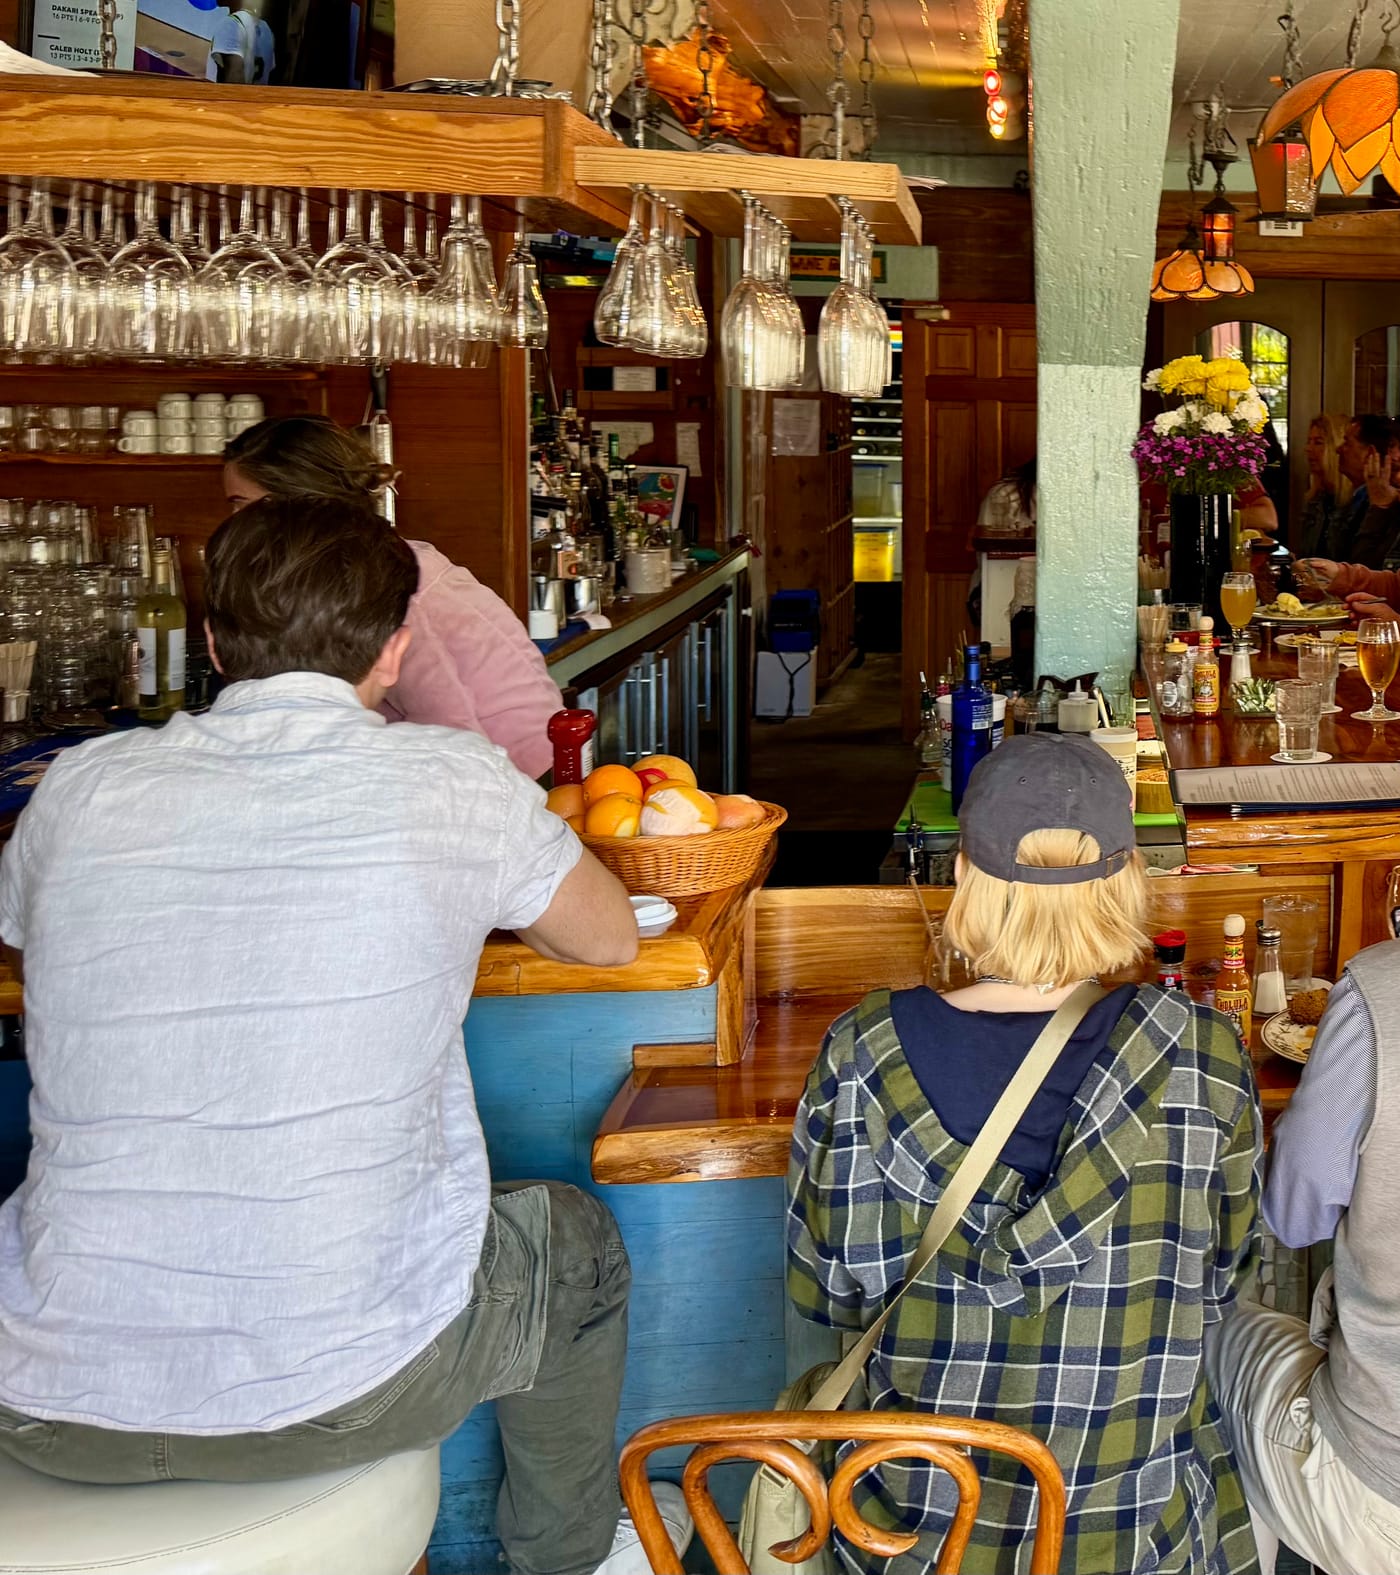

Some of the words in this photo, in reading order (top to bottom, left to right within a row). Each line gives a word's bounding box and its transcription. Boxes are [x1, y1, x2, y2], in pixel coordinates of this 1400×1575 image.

[52, 5, 79, 14] DAKARI
[49, 44, 73, 53] CALEB
[74, 47, 92, 56] HOLT
[59, 53, 72, 61] PTS
